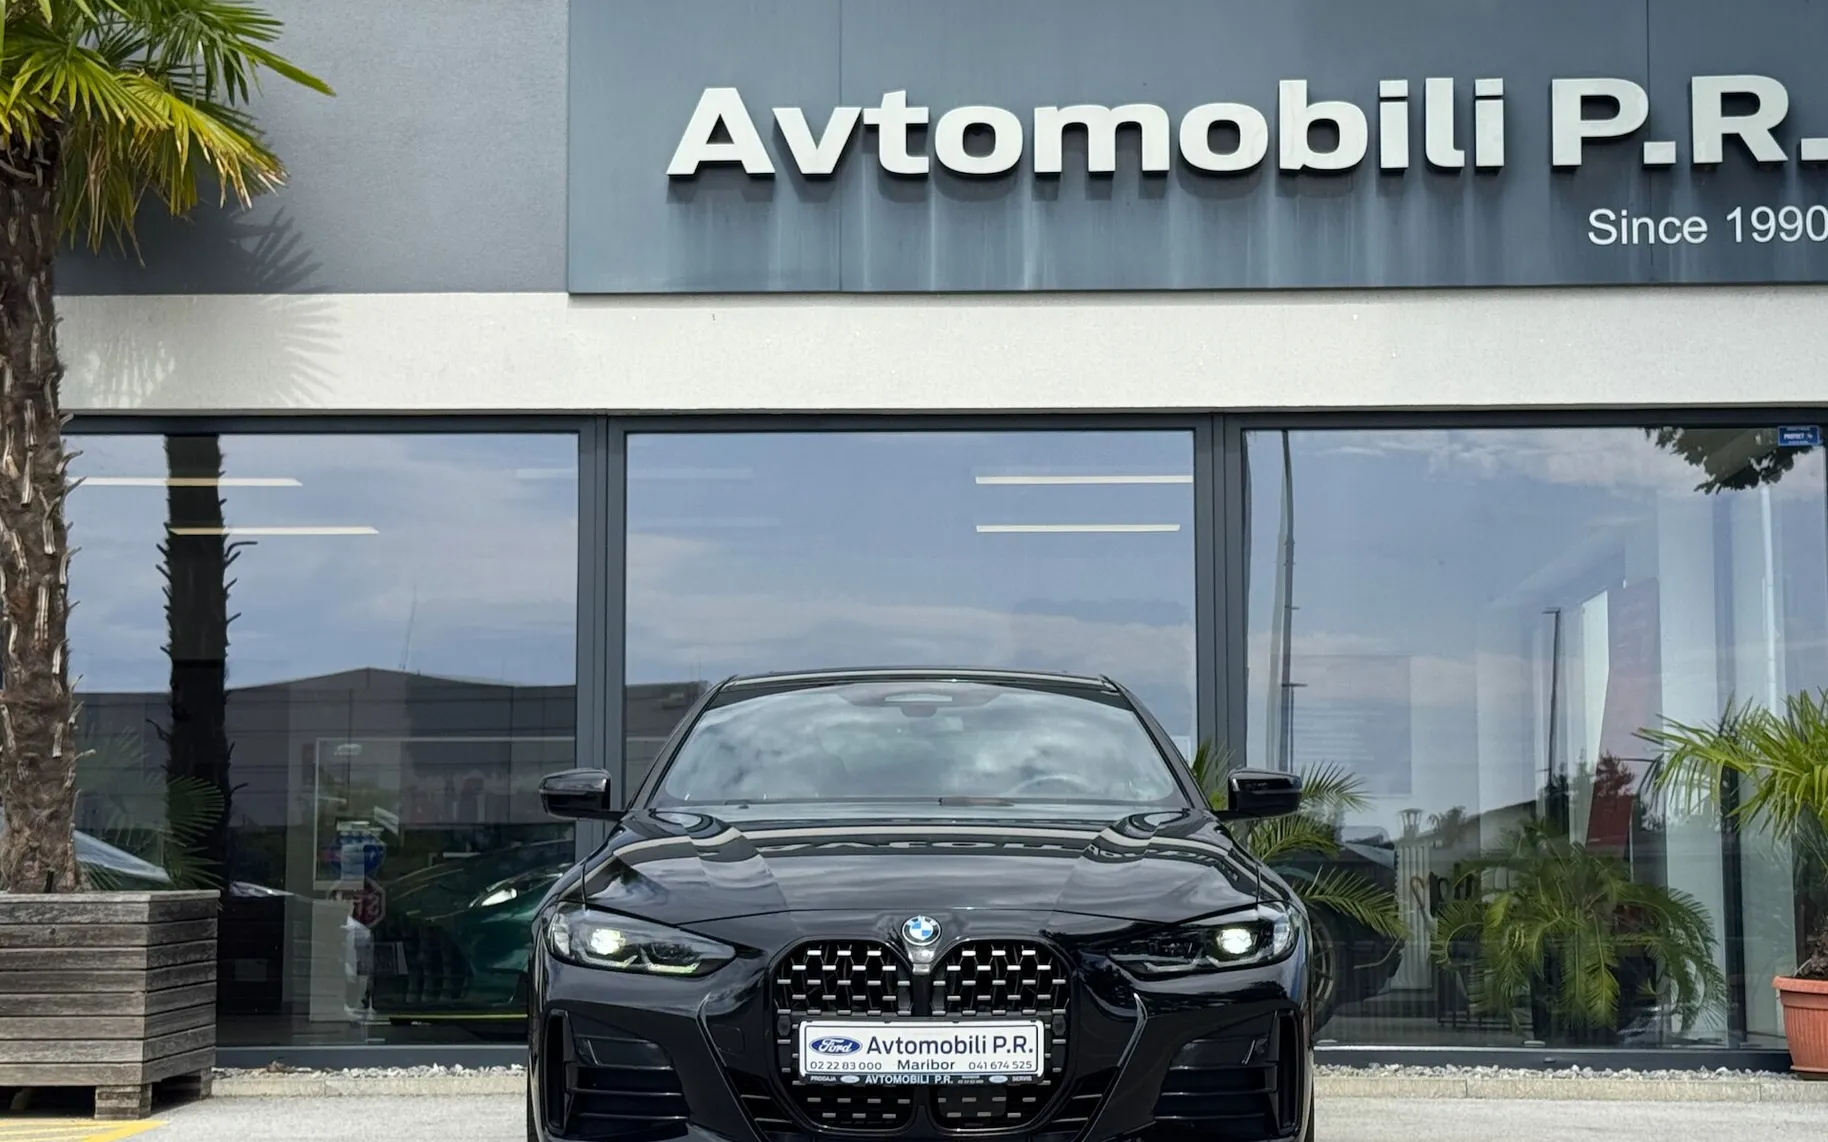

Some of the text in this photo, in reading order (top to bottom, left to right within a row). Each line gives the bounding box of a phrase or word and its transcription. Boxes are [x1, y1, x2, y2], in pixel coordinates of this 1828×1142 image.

[666, 74, 1828, 176] Avtomobili P.R.
[1588, 205, 1828, 245] Since 1990
[866, 1035, 986, 1055] Avtomobili
[993, 1035, 1033, 1054] P.R.
[858, 1061, 882, 1070] 000
[897, 1059, 955, 1070] Maribor
[969, 1061, 987, 1070] 041
[990, 1061, 1009, 1070] 674
[1012, 1060, 1032, 1070] 525
[865, 1074, 929, 1084] AVTOMOBILI
[934, 1074, 953, 1084] P.R.
